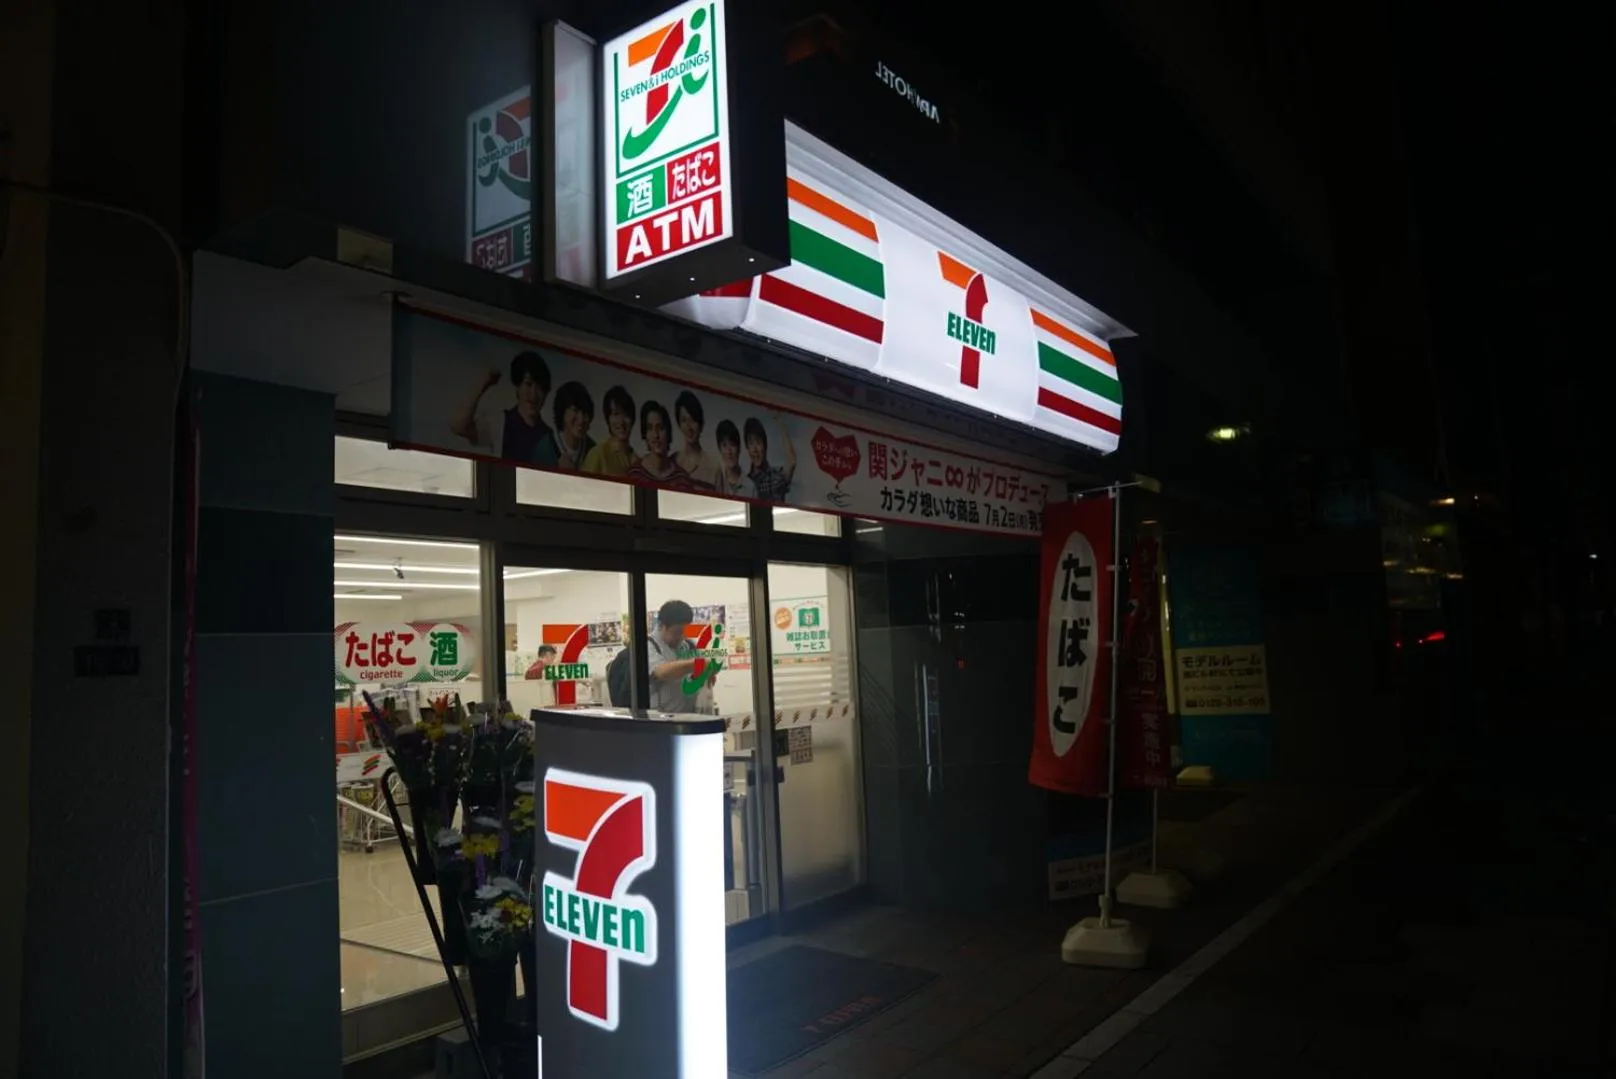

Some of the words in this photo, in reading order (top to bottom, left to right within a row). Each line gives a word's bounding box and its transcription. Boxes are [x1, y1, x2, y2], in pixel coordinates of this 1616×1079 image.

[660, 50, 710, 84] HOLDINGS
[672, 151, 716, 200] たばこ
[627, 173, 653, 218] 酒
[625, 197, 715, 265] ATM
[937, 251, 989, 390] 7
[880, 486, 980, 525] カラダ想いな商品
[345, 631, 417, 668] たばこ
[430, 632, 458, 666] 酒
[795, 641, 826, 651] サービス
[1053, 553, 1092, 735] たばこ
[1181, 653, 1262, 669] モデルルーム
[360, 669, 403, 680] cigarette
[433, 668, 459, 678] liquor
[546, 780, 644, 1021] 7
